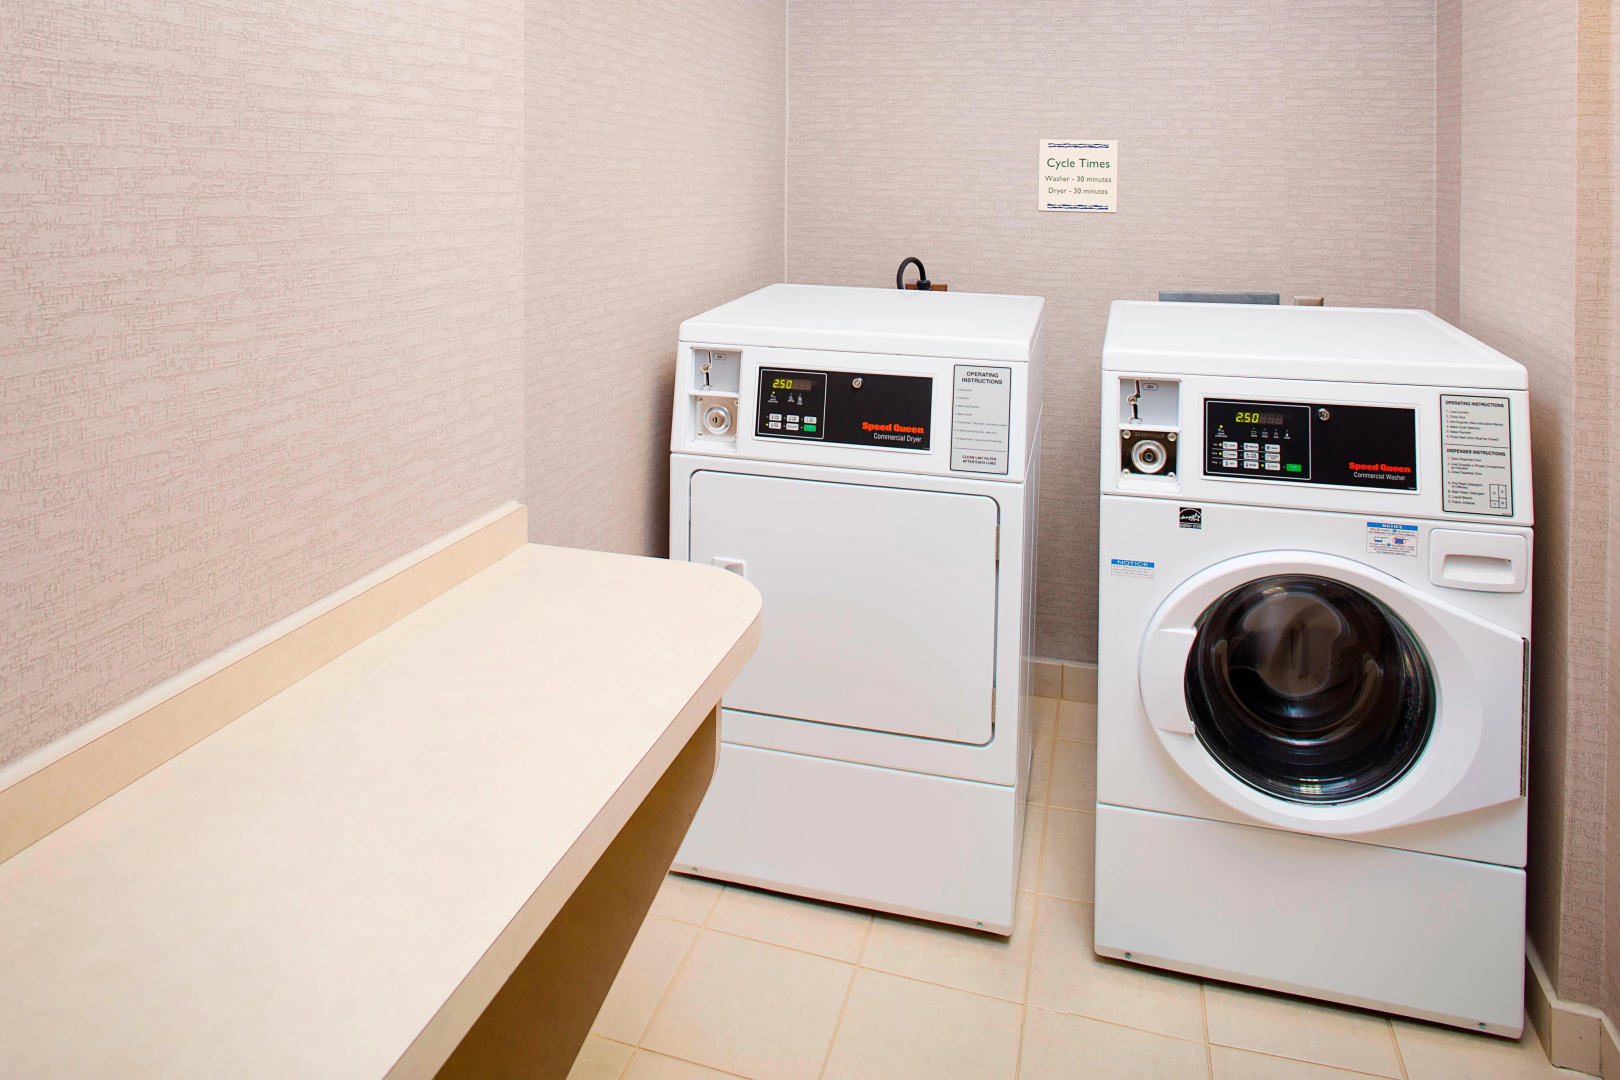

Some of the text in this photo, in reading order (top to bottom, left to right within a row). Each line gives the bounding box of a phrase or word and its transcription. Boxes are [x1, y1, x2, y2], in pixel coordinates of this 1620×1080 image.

[1046, 158, 1110, 170] Cycle Times
[1048, 187, 1067, 195] Dryer
[772, 379, 793, 389] 2.50
[1236, 412, 1260, 423] 2.50
[862, 422, 924, 433] Speed Queen
[874, 433, 905, 441] Commercial
[1349, 462, 1411, 473] Speed Queen
[1354, 471, 1384, 479] Commercial
